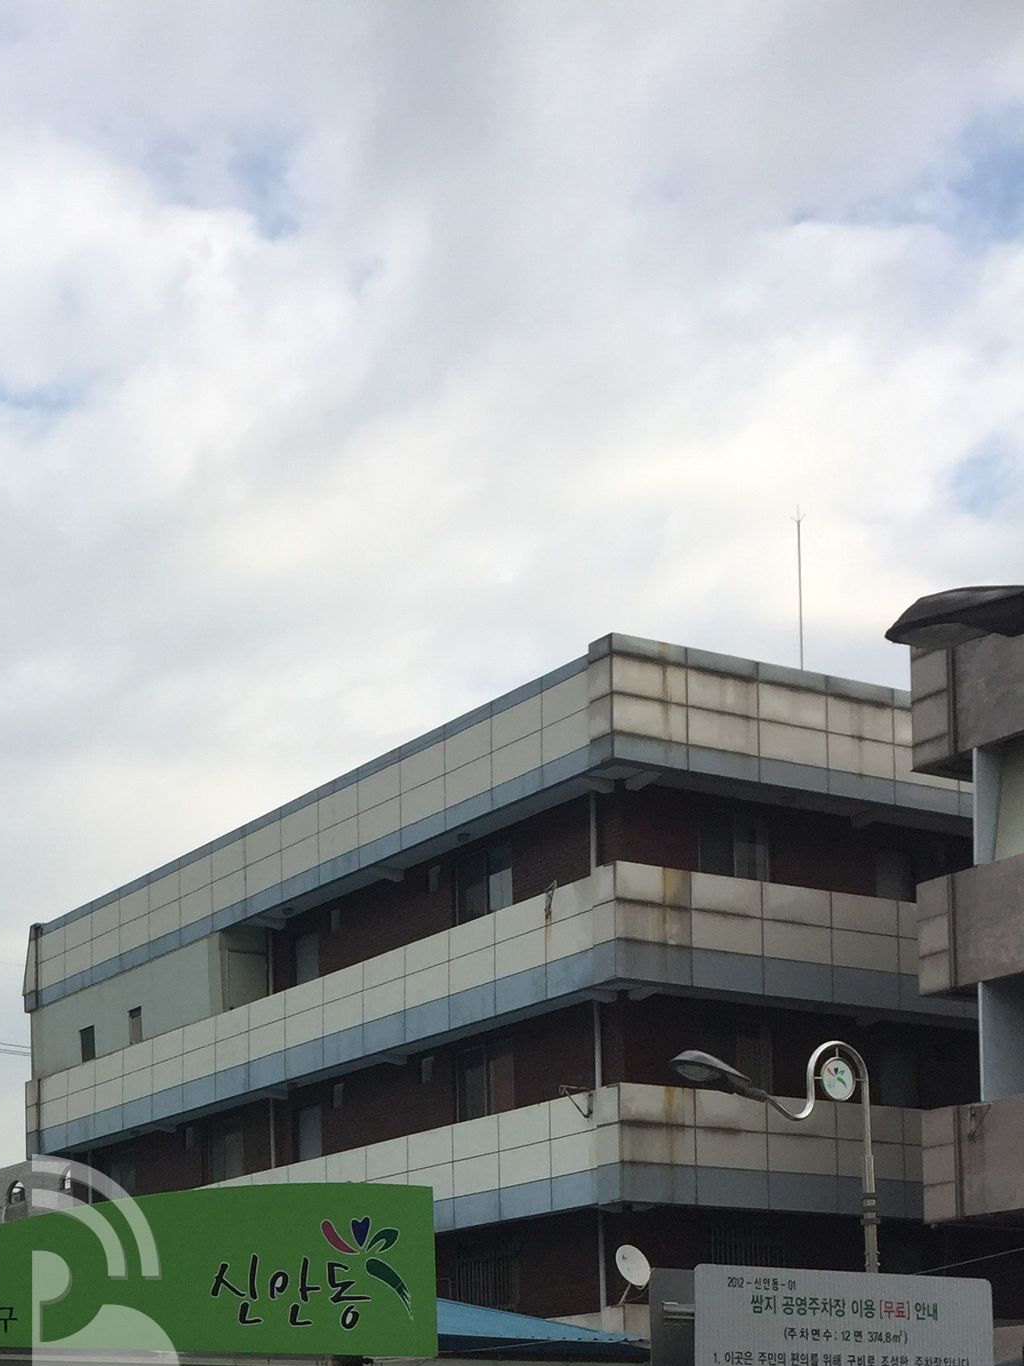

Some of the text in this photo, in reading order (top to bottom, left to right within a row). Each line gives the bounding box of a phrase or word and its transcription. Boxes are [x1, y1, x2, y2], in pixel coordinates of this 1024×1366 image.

[210, 1252, 372, 1330] 신안동
[751, 1294, 777, 1314] 쌈지
[782, 1296, 846, 1317] 공영주차장
[851, 1299, 876, 1319] 이용
[914, 1302, 938, 1321] 안내
[724, 1351, 753, 1366] 이곳은
[758, 1352, 786, 1366] 주민의
[823, 1354, 842, 1366] 위해
